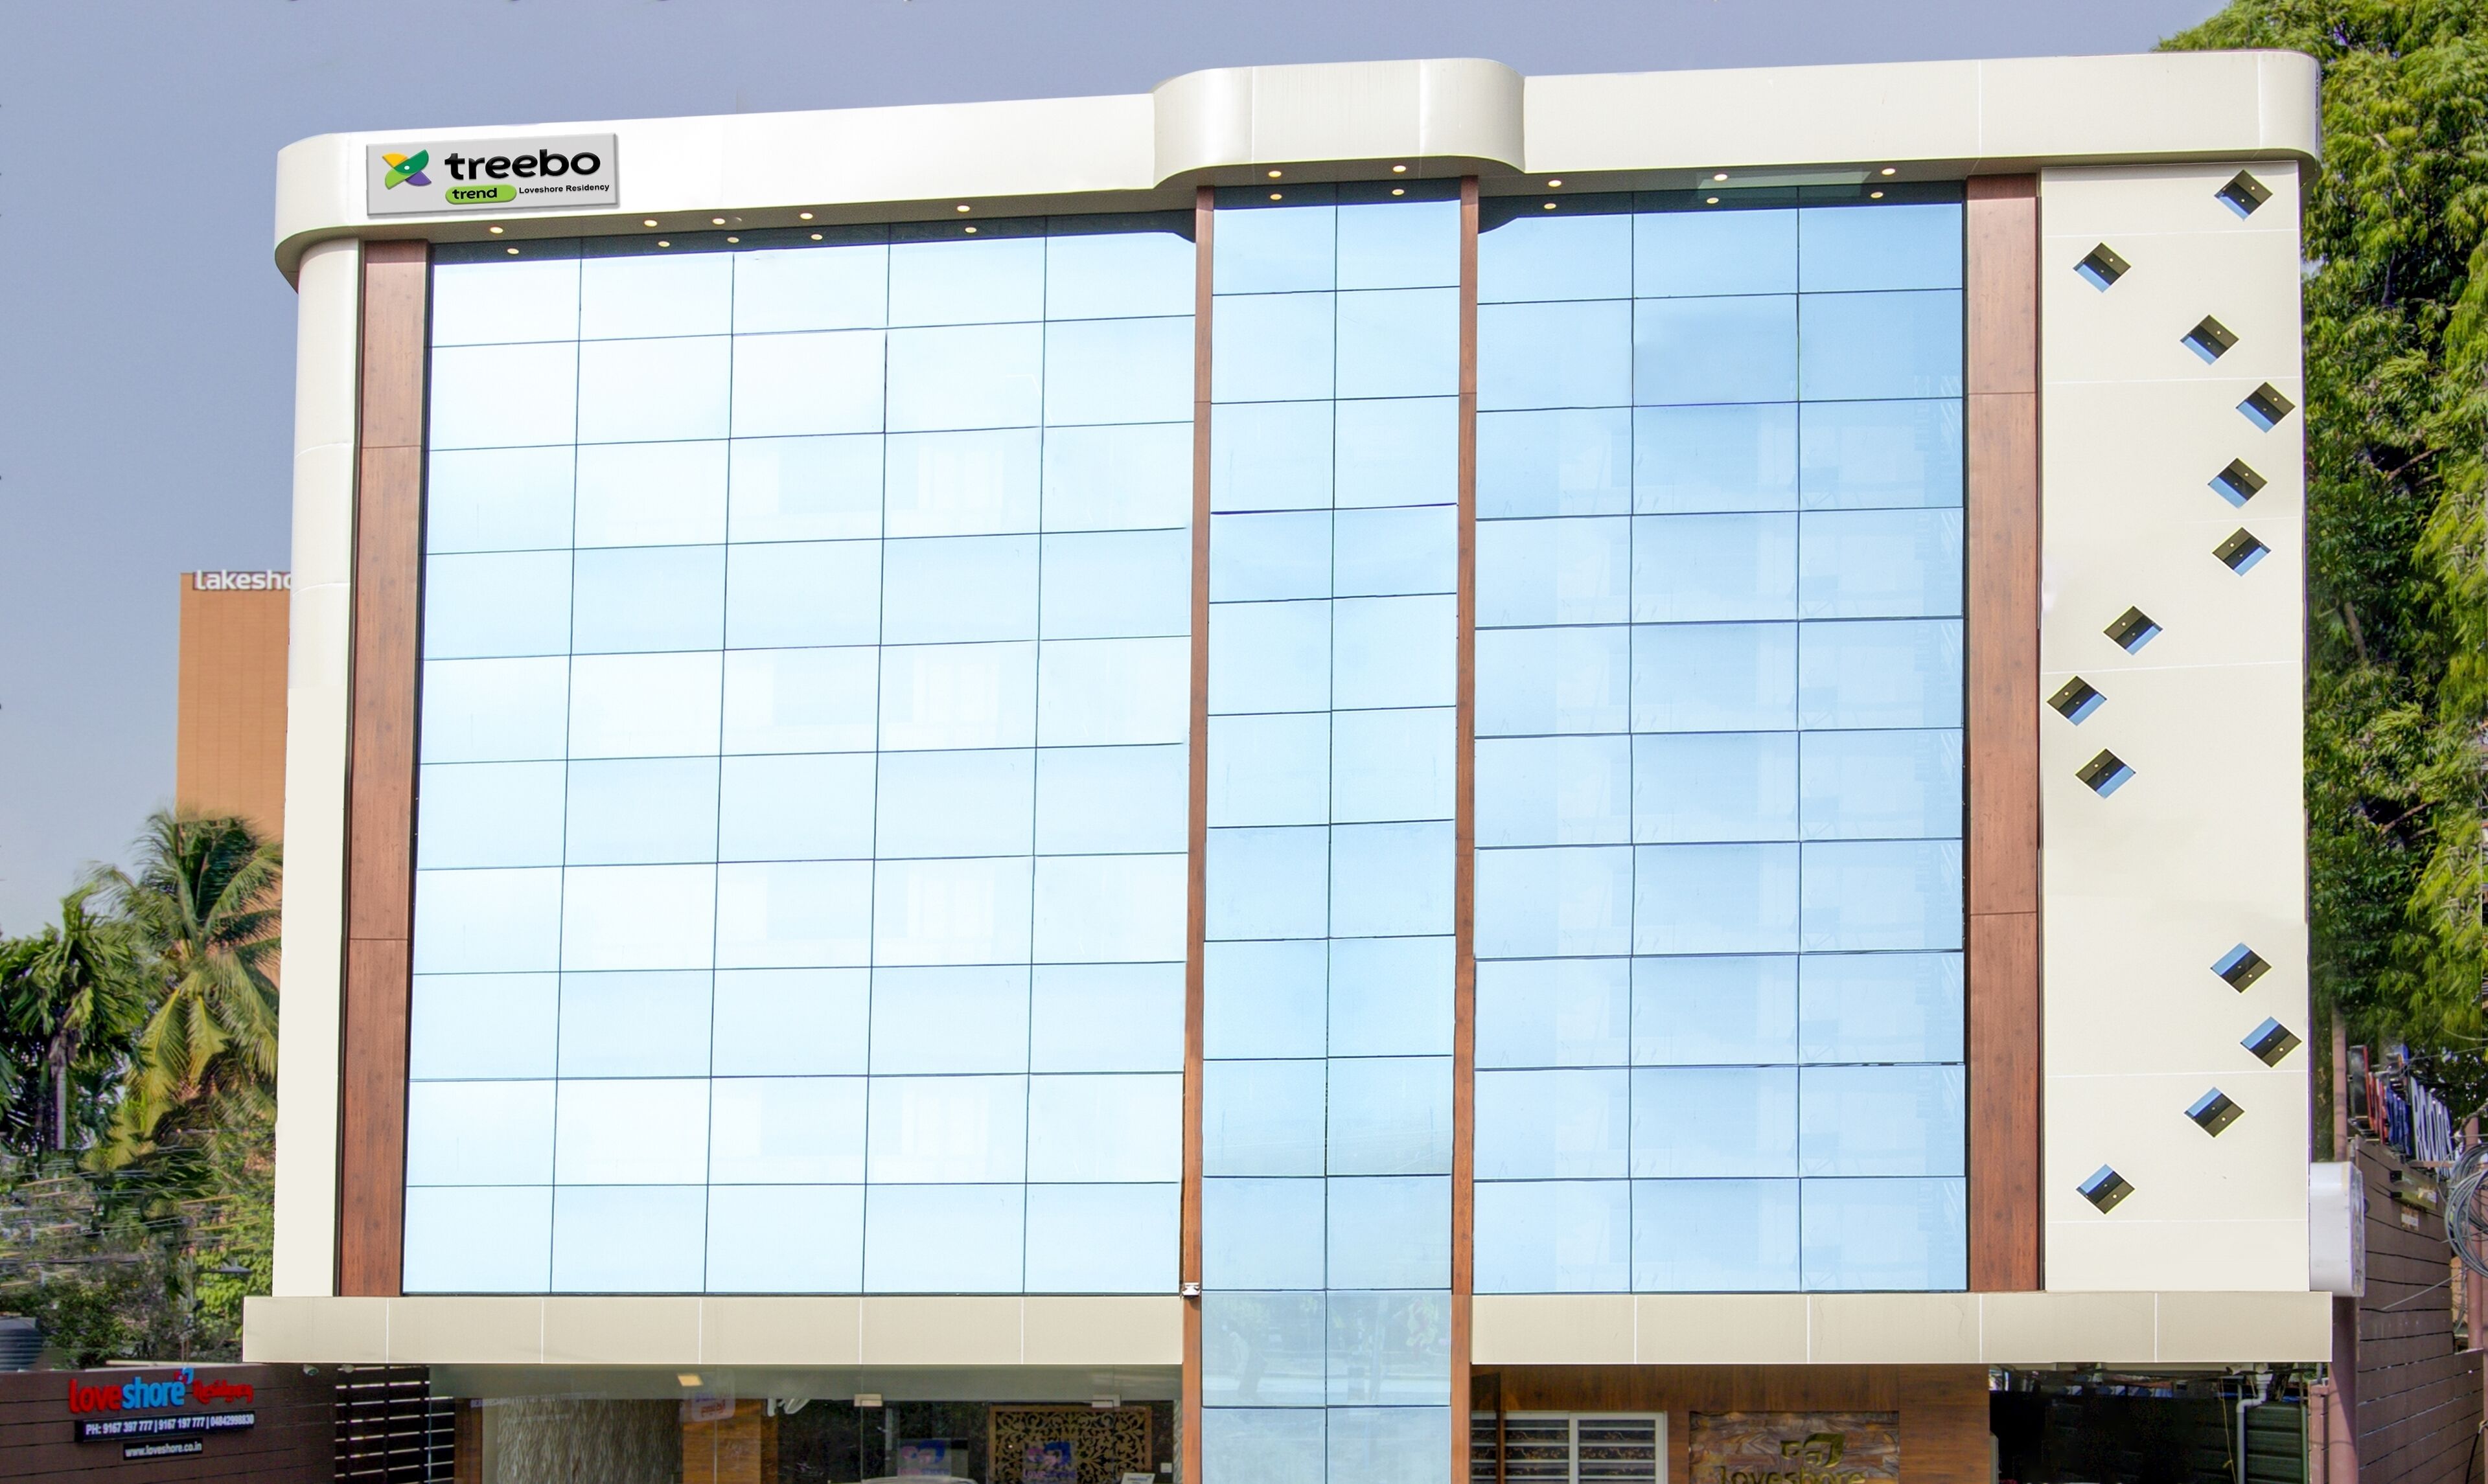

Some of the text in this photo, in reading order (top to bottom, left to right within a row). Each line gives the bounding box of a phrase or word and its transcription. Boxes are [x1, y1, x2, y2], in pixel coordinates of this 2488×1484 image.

[444, 149, 601, 179] treebo
[452, 187, 498, 200] trend
[519, 185, 563, 194] Loveshore
[69, 1376, 186, 1413] loveshore
[86, 1424, 102, 1435] PH:
[102, 1422, 122, 1434] 9167
[139, 1420, 154, 1431] 777
[159, 1419, 176, 1430] 9167
[178, 1417, 191, 1428] 197
[192, 1417, 205, 1428] 777
[125, 1441, 202, 1457] www.loveshore.co.in
